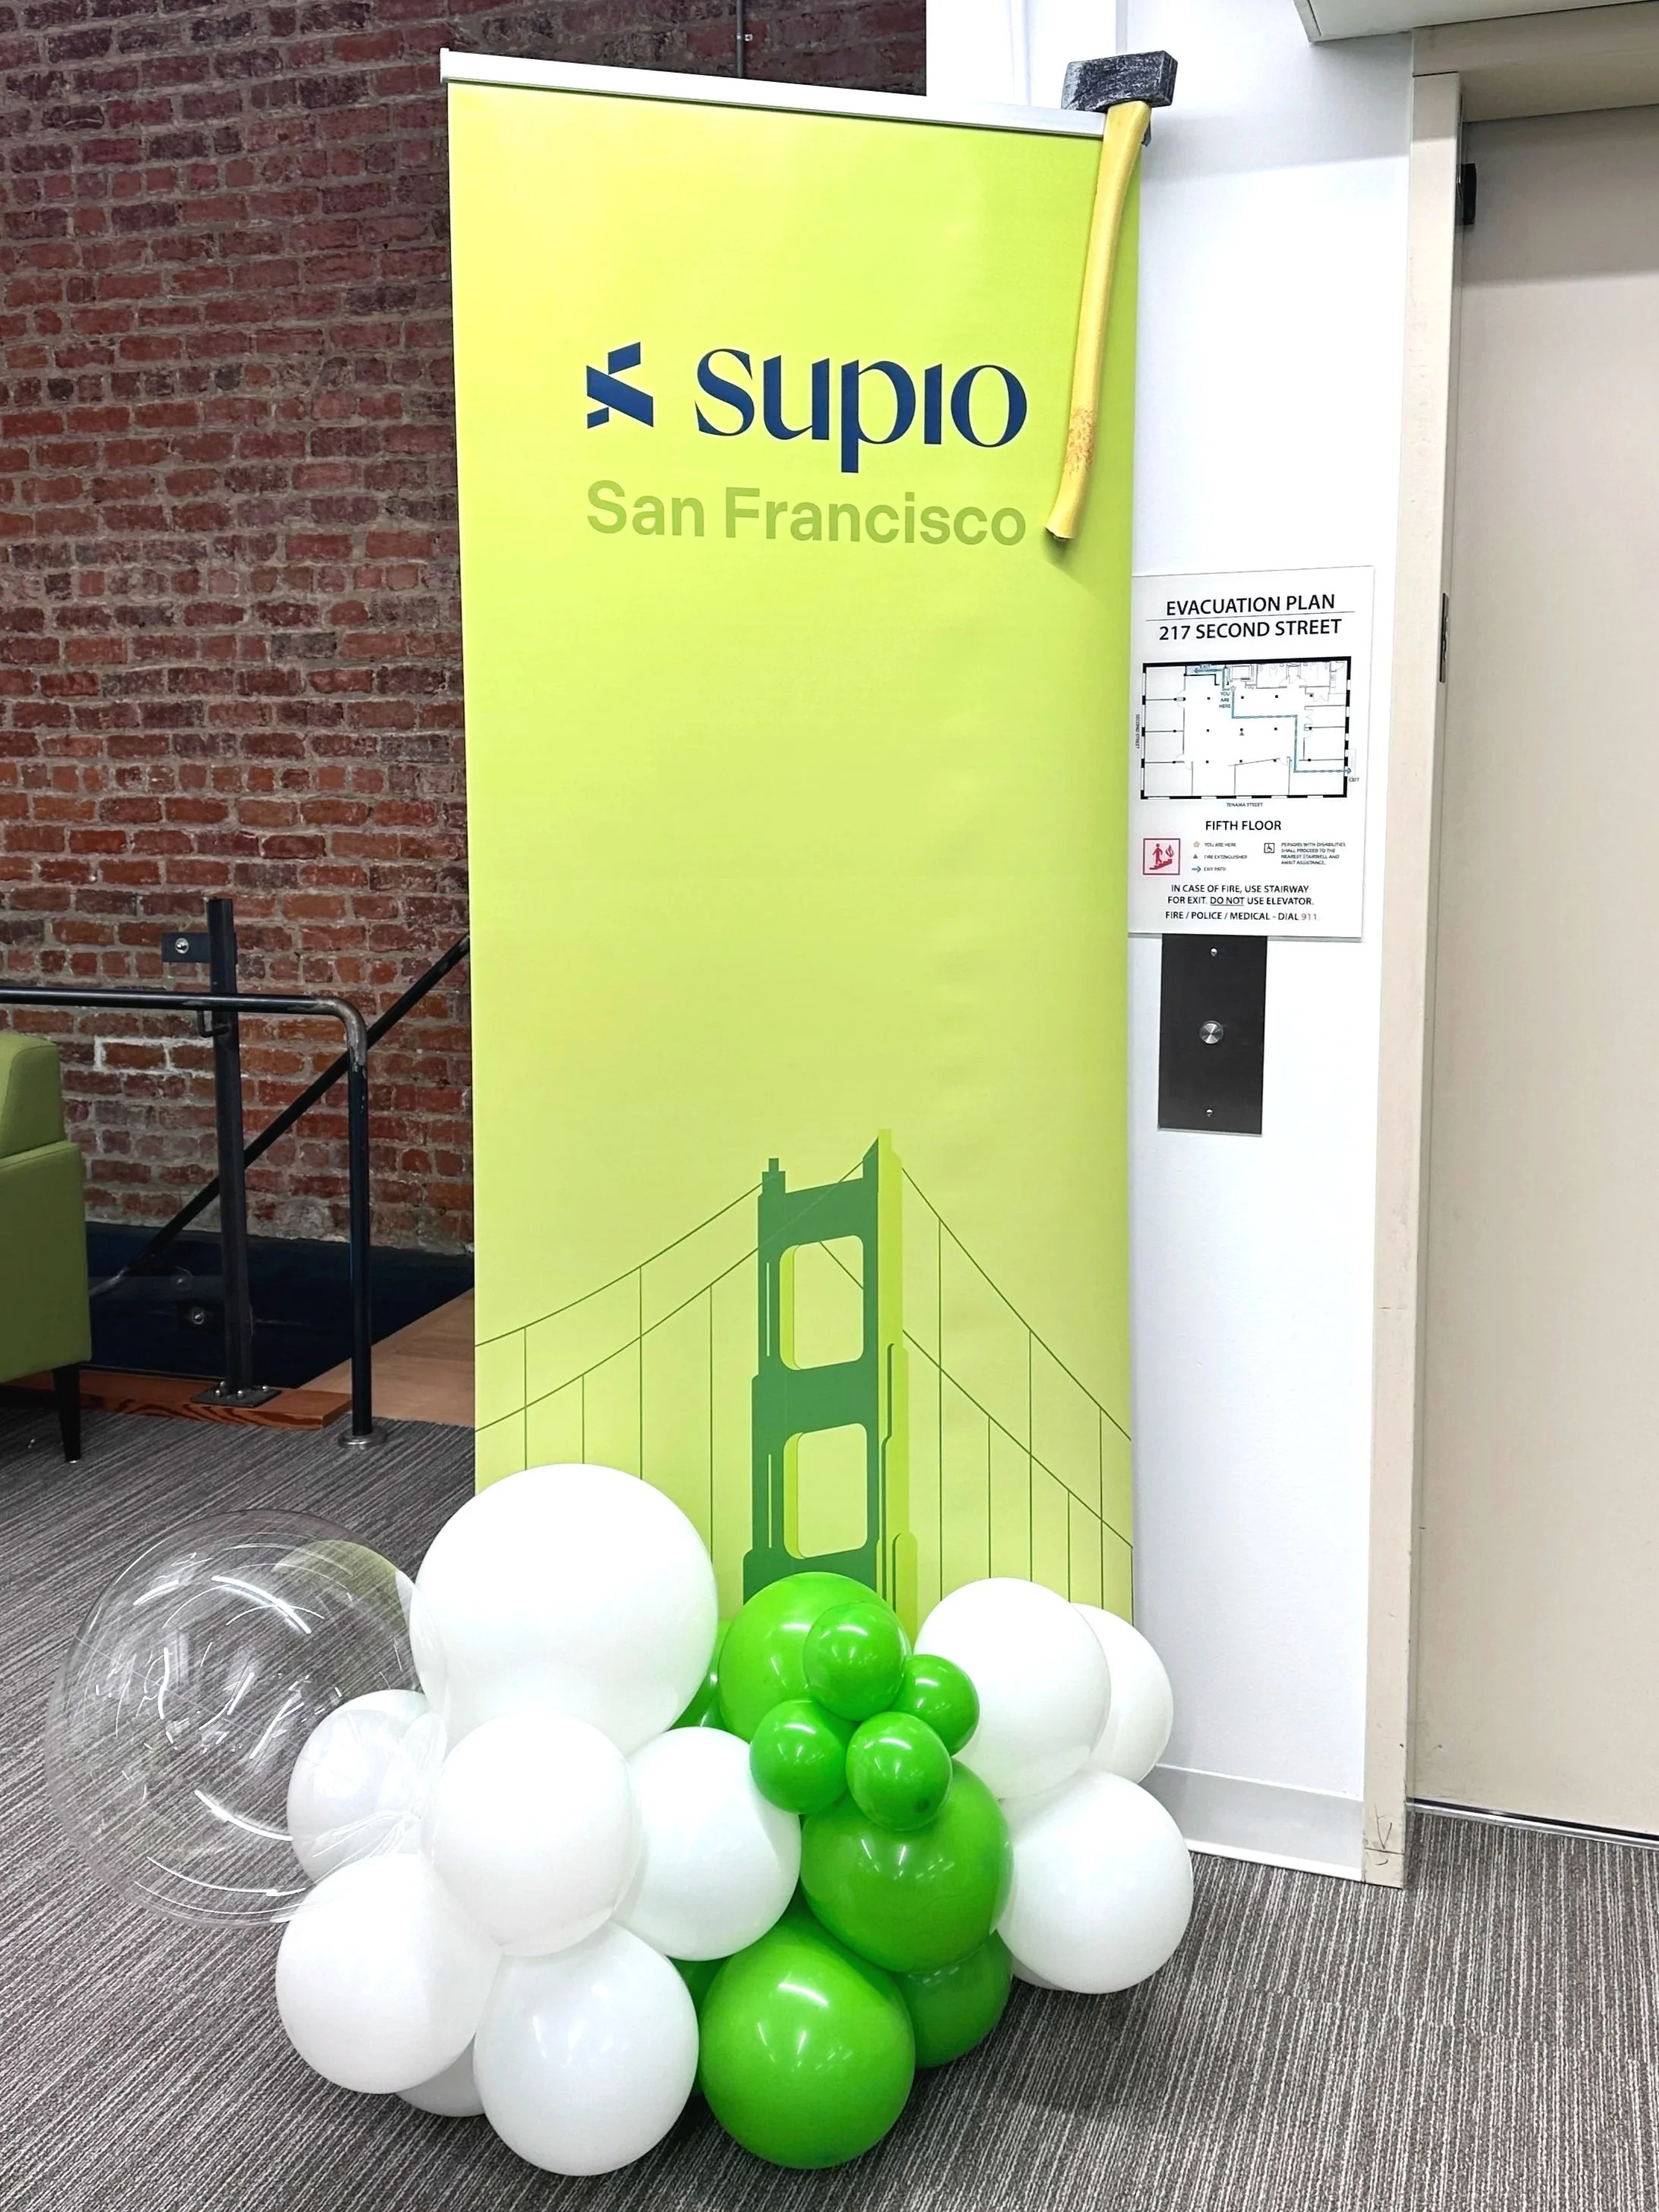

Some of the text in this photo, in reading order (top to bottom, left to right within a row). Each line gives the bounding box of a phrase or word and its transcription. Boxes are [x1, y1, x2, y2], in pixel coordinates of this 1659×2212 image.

[694, 348, 1028, 474] supio
[587, 480, 1027, 546] San Francisco
[1166, 594, 1335, 616] EVACUATION PLAN
[1159, 618, 1343, 640] 217 SECOND STREET
[1205, 820, 1282, 831] FIFTH FLOOR
[1171, 884, 1180, 892] IN
[1182, 884, 1205, 892] CASE
[1221, 885, 1242, 894] FIRE,
[1226, 897, 1245, 905] NOT
[1229, 912, 1270, 920] MEDICAL
